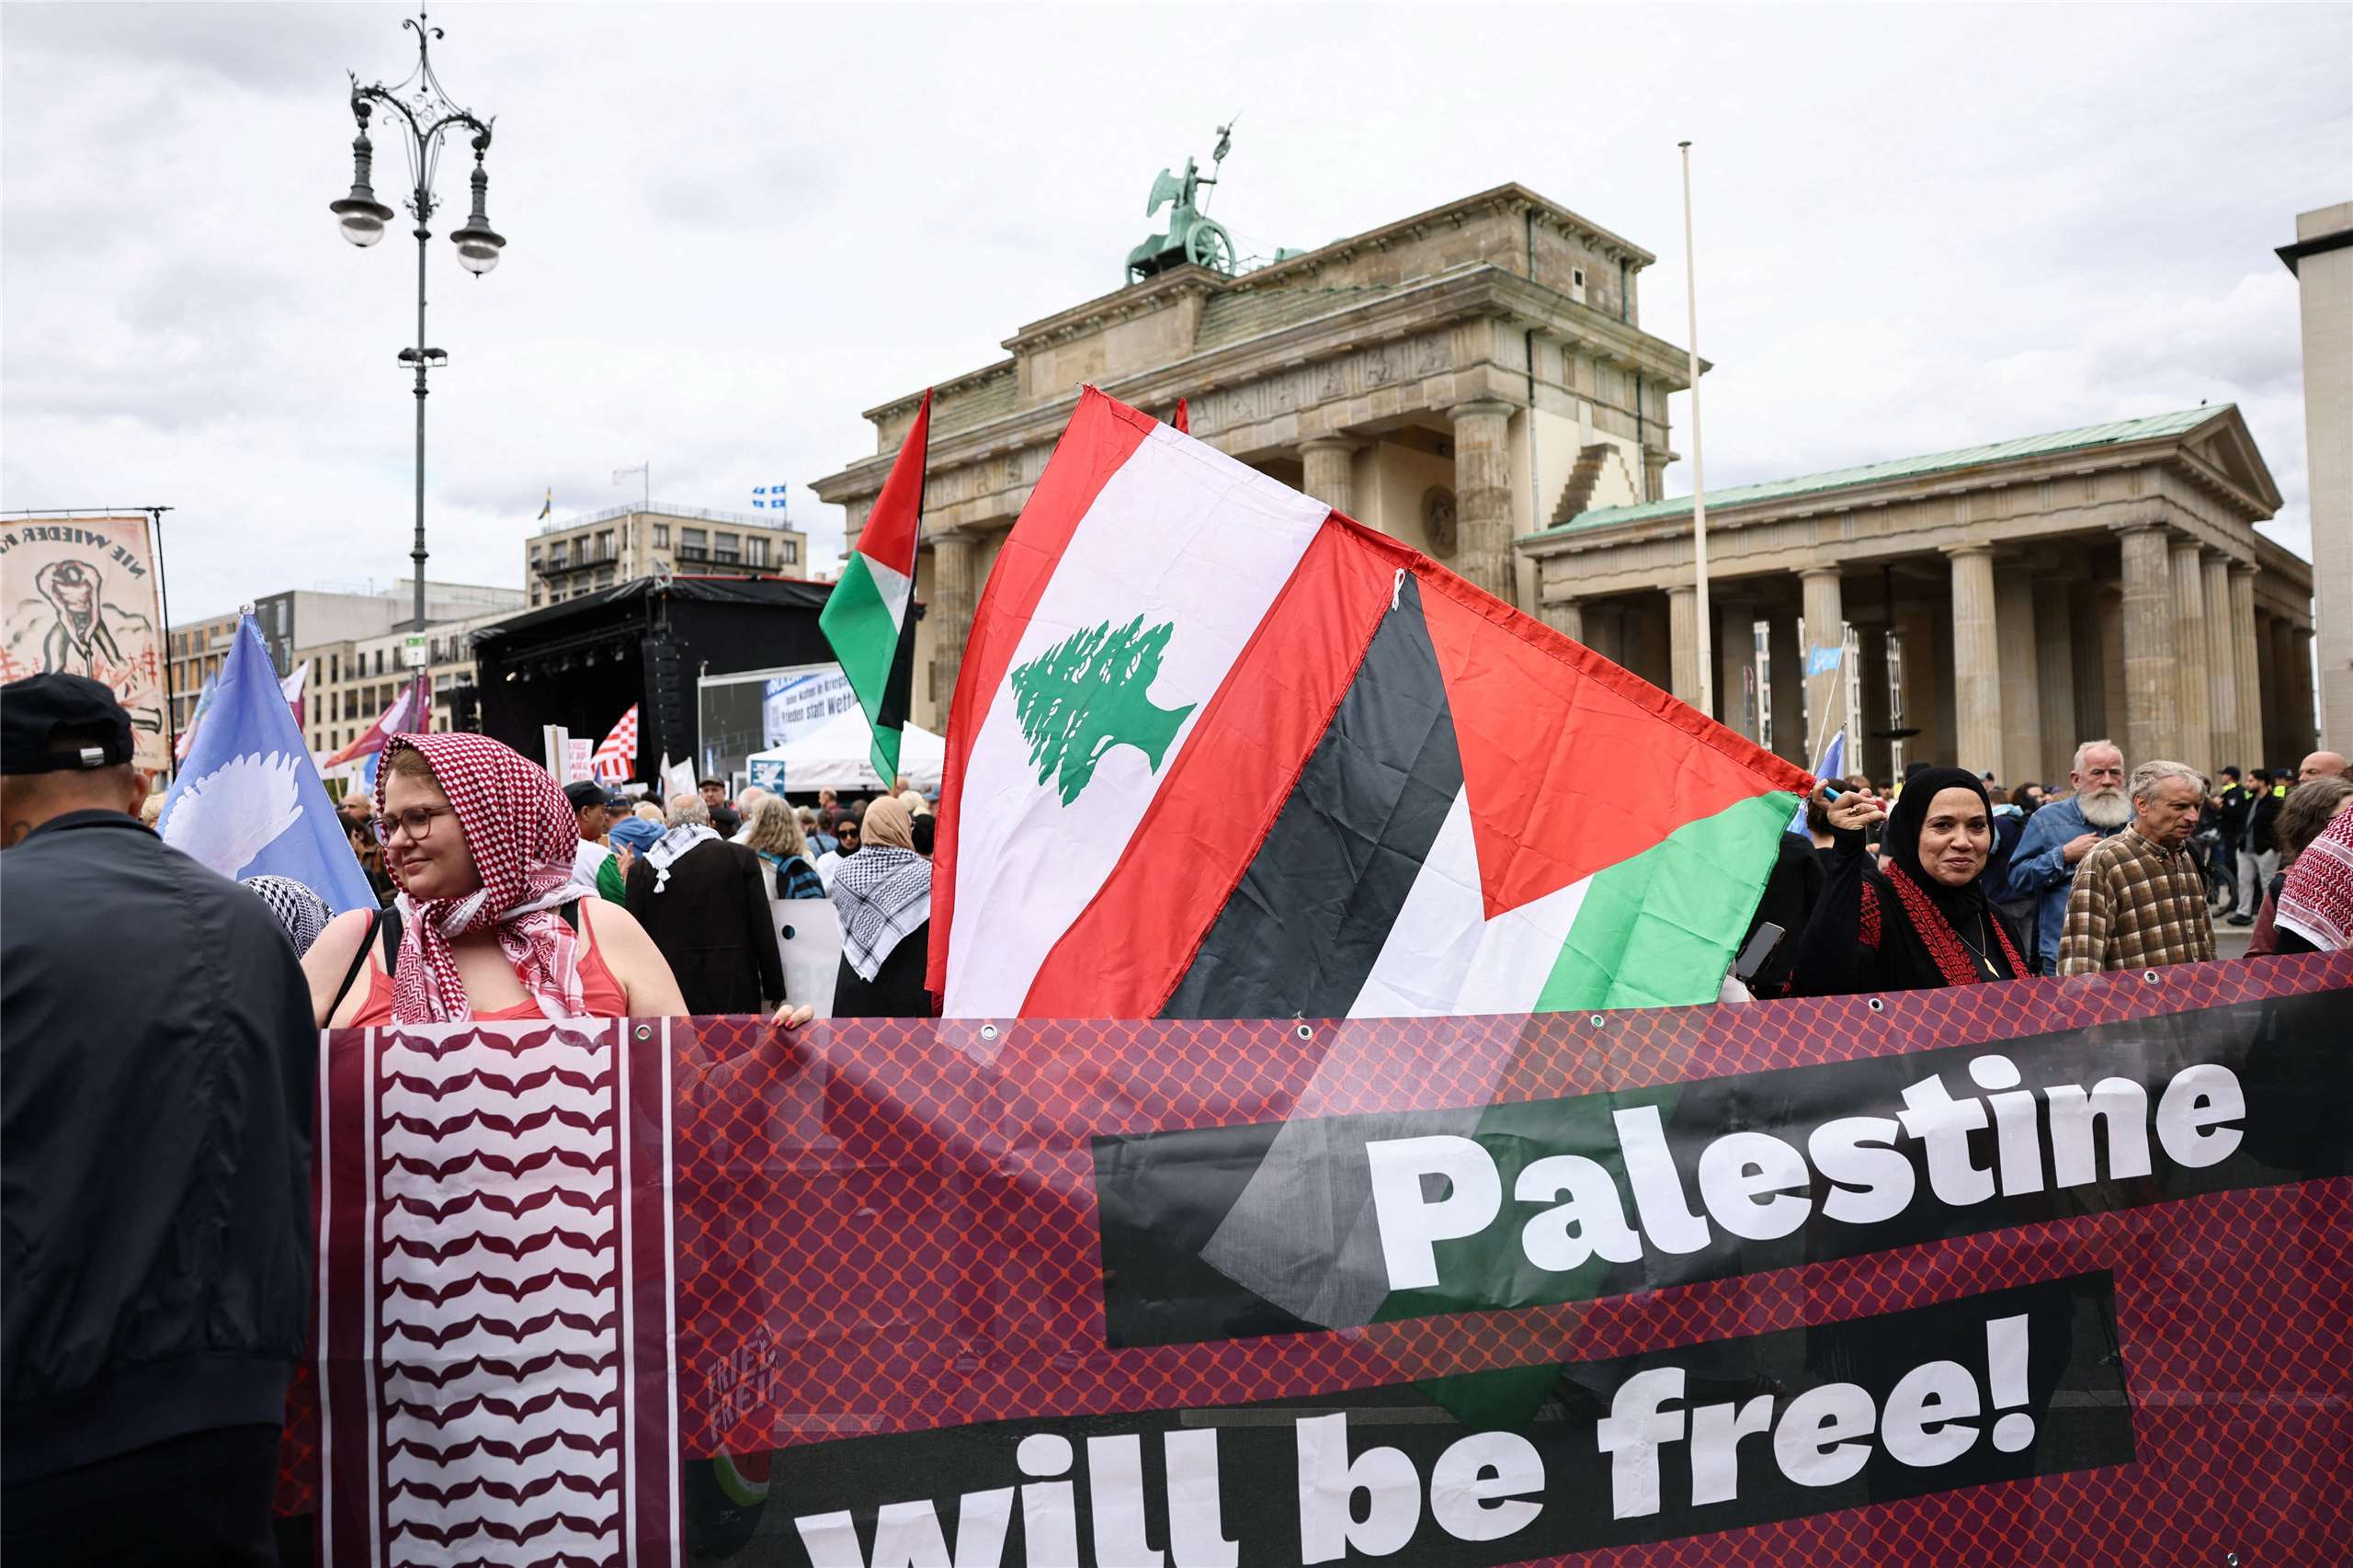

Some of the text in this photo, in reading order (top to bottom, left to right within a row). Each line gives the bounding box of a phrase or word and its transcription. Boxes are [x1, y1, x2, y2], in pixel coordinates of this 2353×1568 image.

[1365, 1054, 2245, 1291] Palestine
[794, 1313, 2037, 1568] will be free!
